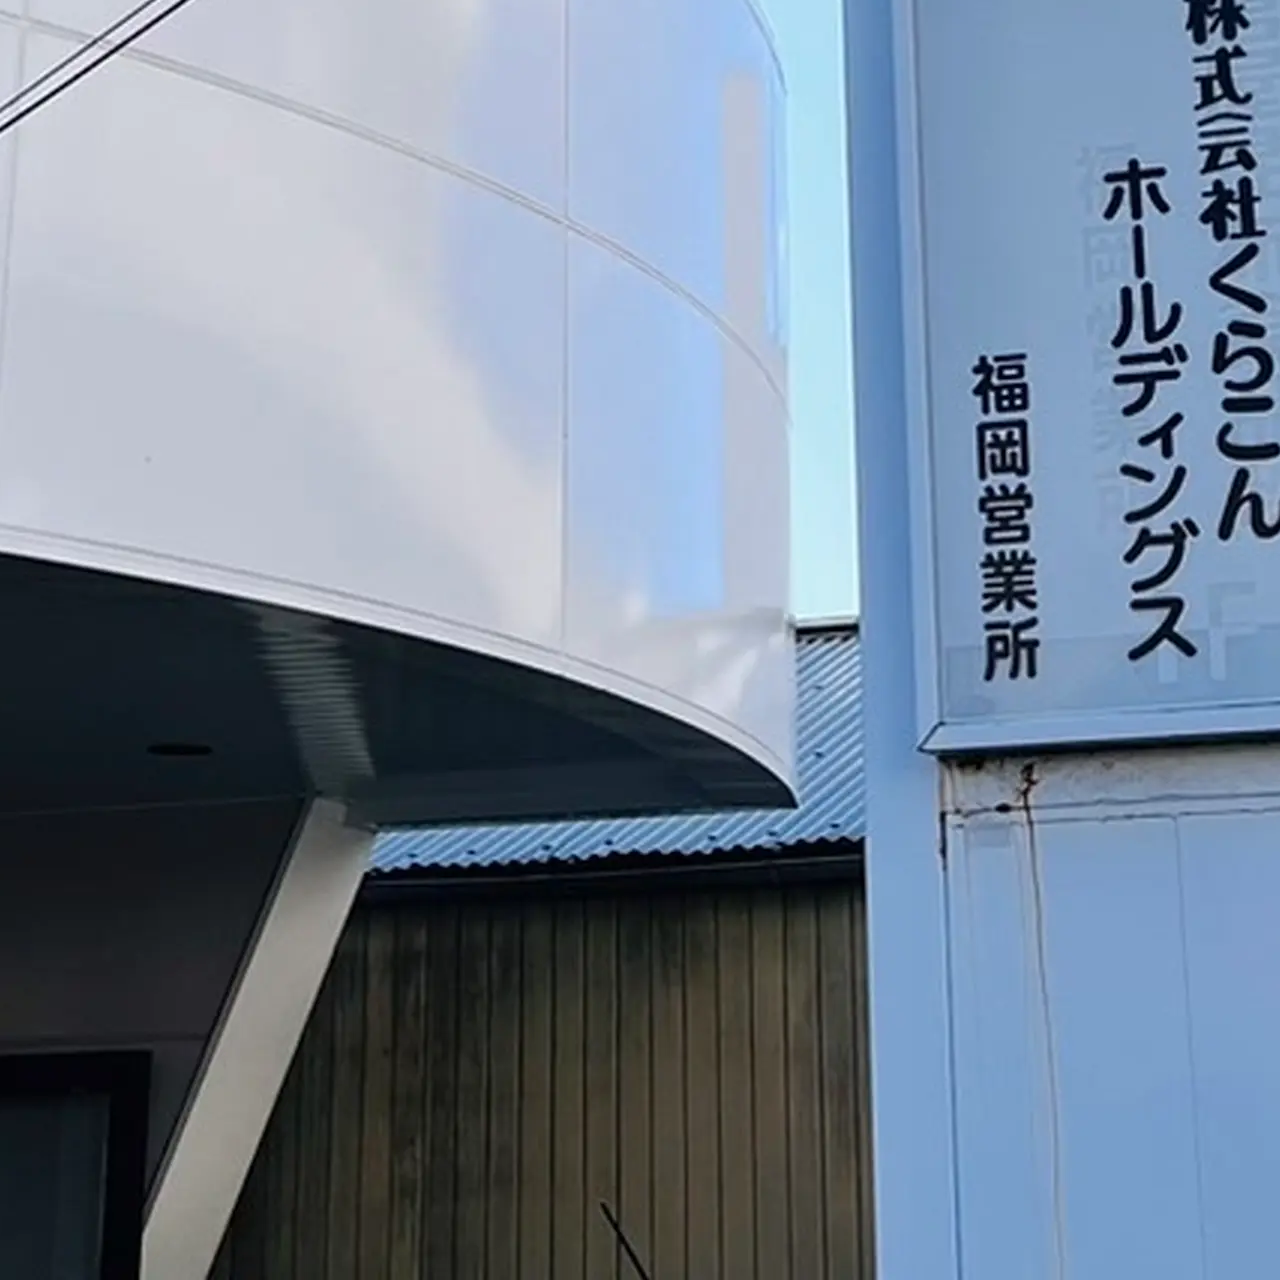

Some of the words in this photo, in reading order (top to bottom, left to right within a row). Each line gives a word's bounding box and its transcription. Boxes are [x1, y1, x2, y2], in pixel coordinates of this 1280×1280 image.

[972, 351, 1040, 682] 福岡営業所
[1103, 158, 1200, 662] ホールディングス
